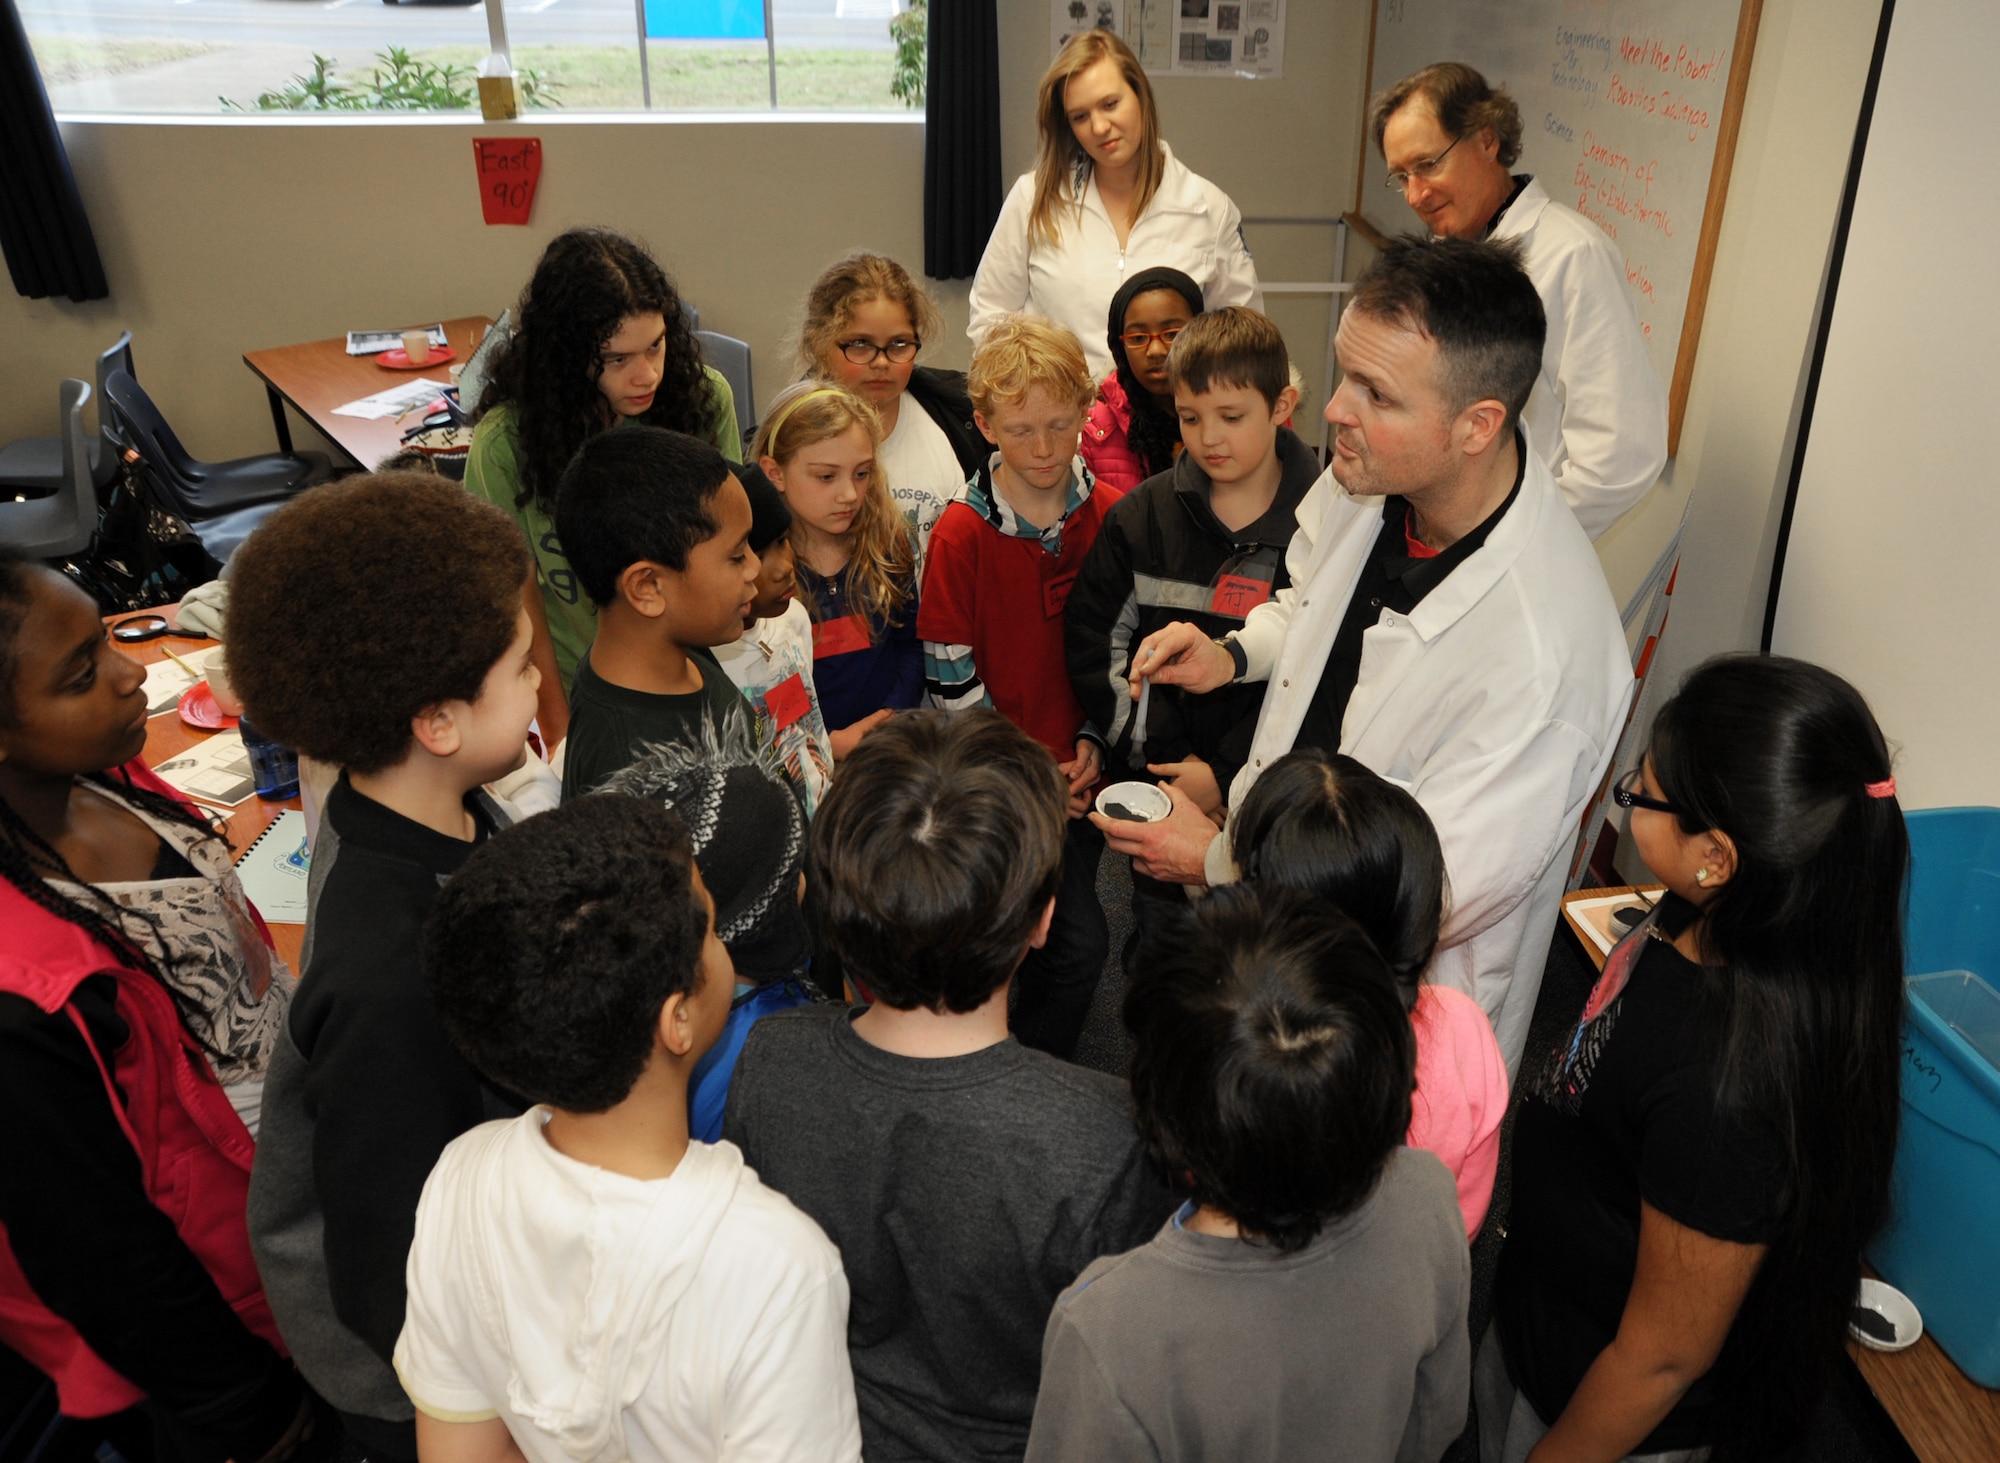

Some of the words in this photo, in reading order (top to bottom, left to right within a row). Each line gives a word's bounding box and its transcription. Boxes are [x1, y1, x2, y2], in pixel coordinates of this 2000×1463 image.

[1617, 35, 1650, 65] Meet
[1650, 39, 1671, 73] the
[1673, 43, 1726, 83] Robot!
[1606, 72, 1656, 114] Robotics
[480, 141, 534, 174] East
[1583, 129, 1631, 187] Chemistry
[1635, 160, 1659, 196] of
[1224, 591, 1246, 608] TJ
